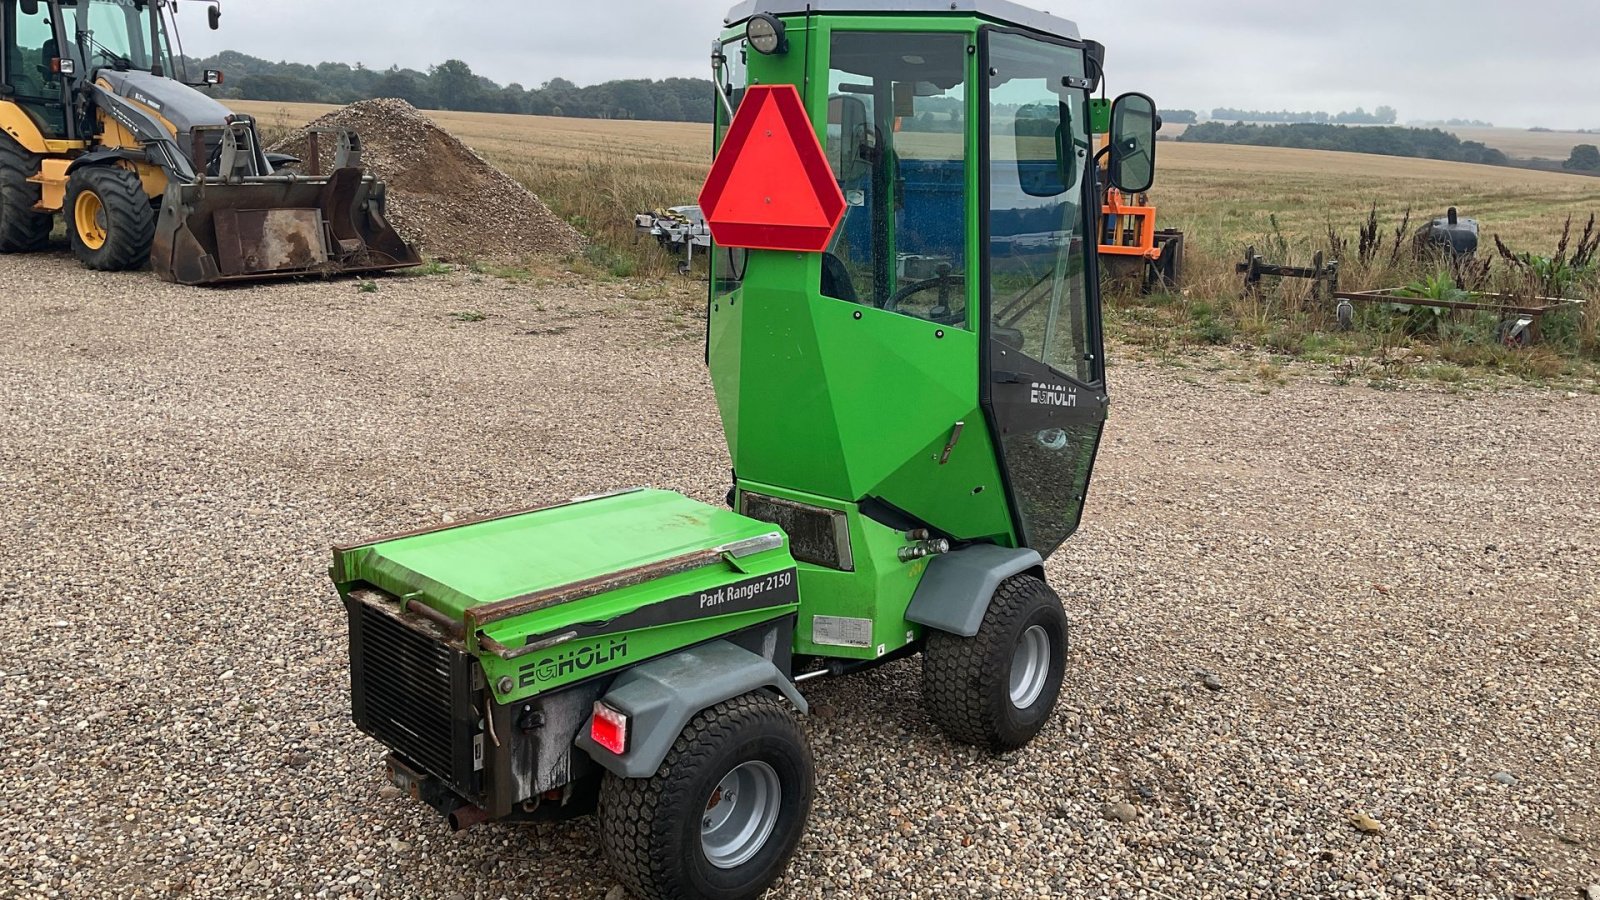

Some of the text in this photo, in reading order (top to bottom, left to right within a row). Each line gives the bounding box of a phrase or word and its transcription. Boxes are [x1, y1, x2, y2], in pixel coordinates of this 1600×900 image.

[1030, 382, 1077, 407] EGHOLM
[700, 572, 791, 609] Park Ranger 2150
[519, 635, 627, 689] EGHOLM
